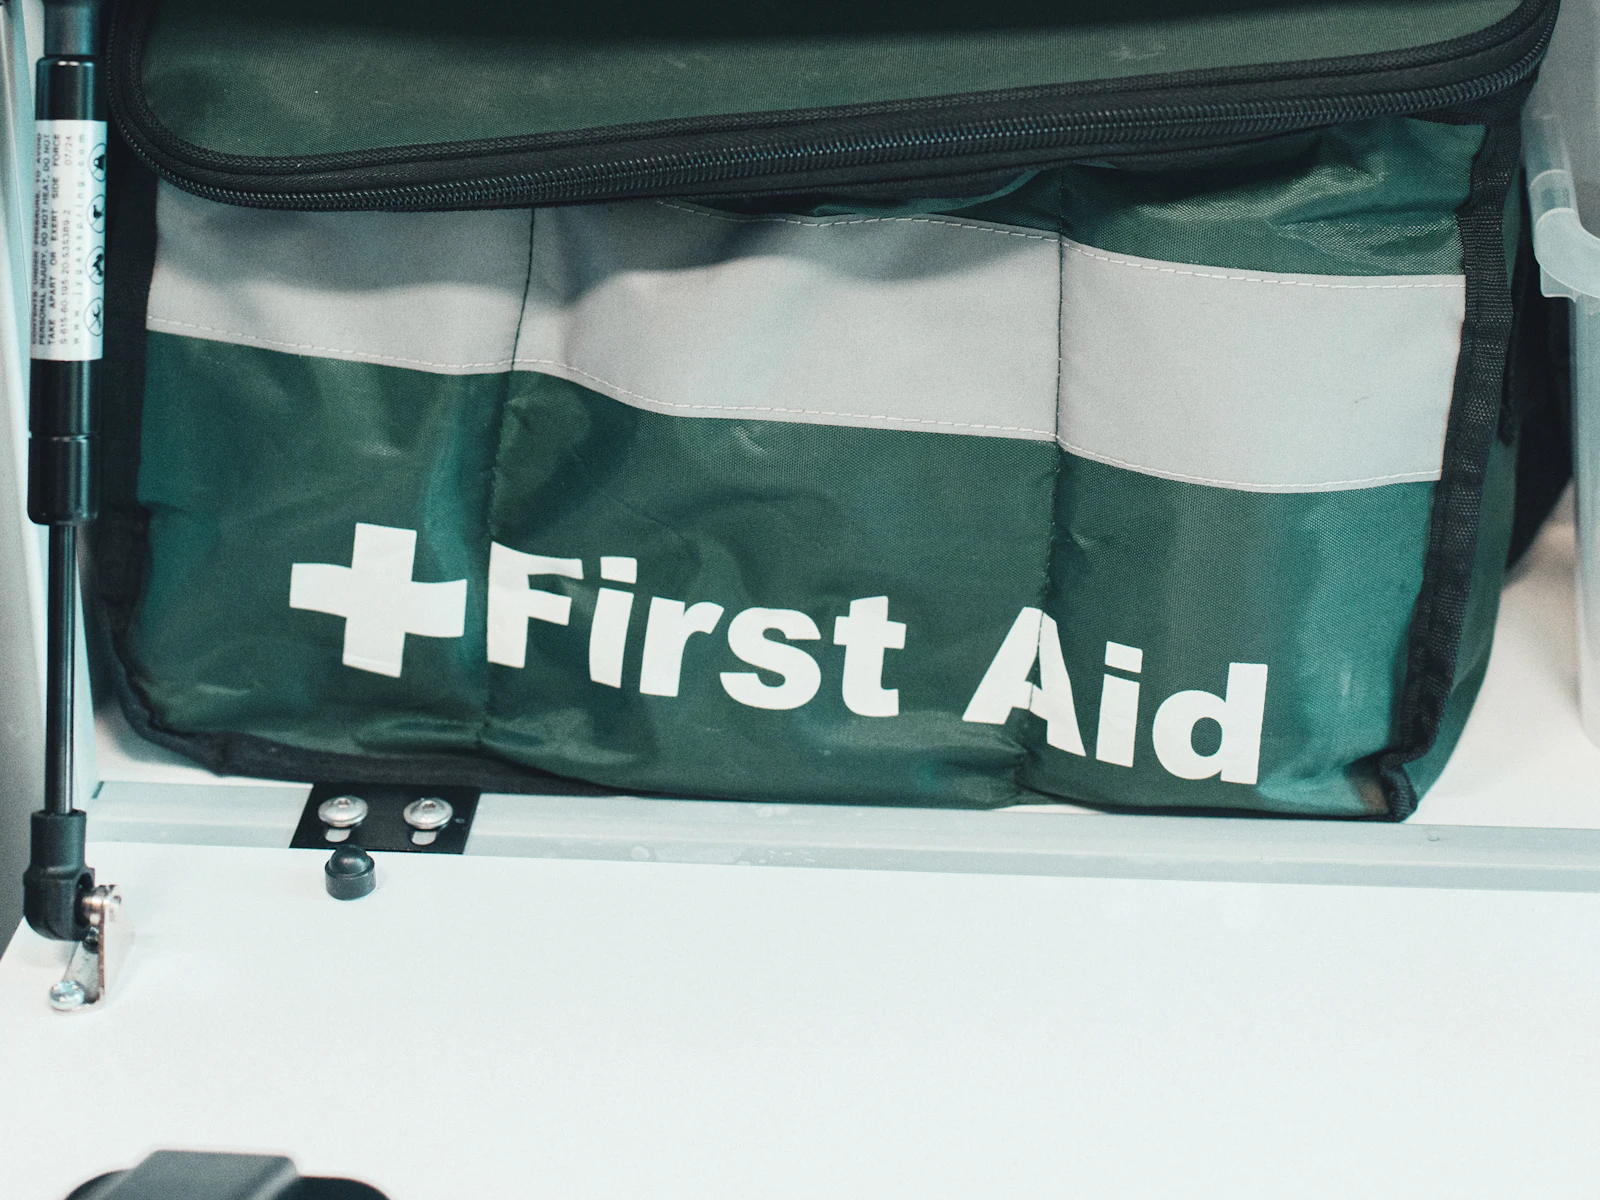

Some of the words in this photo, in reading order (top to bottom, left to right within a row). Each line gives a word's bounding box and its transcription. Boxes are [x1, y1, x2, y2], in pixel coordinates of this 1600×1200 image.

[43, 158, 50, 171] DO
[52, 134, 60, 166] FORCE
[41, 232, 48, 247] DO
[50, 210, 58, 241] EXERT
[49, 252, 57, 265] OR
[48, 276, 56, 308] APART
[38, 294, 46, 345] PERSONAL
[47, 319, 55, 345] TAKE
[487, 541, 906, 717] First
[962, 606, 1268, 784] Aid
